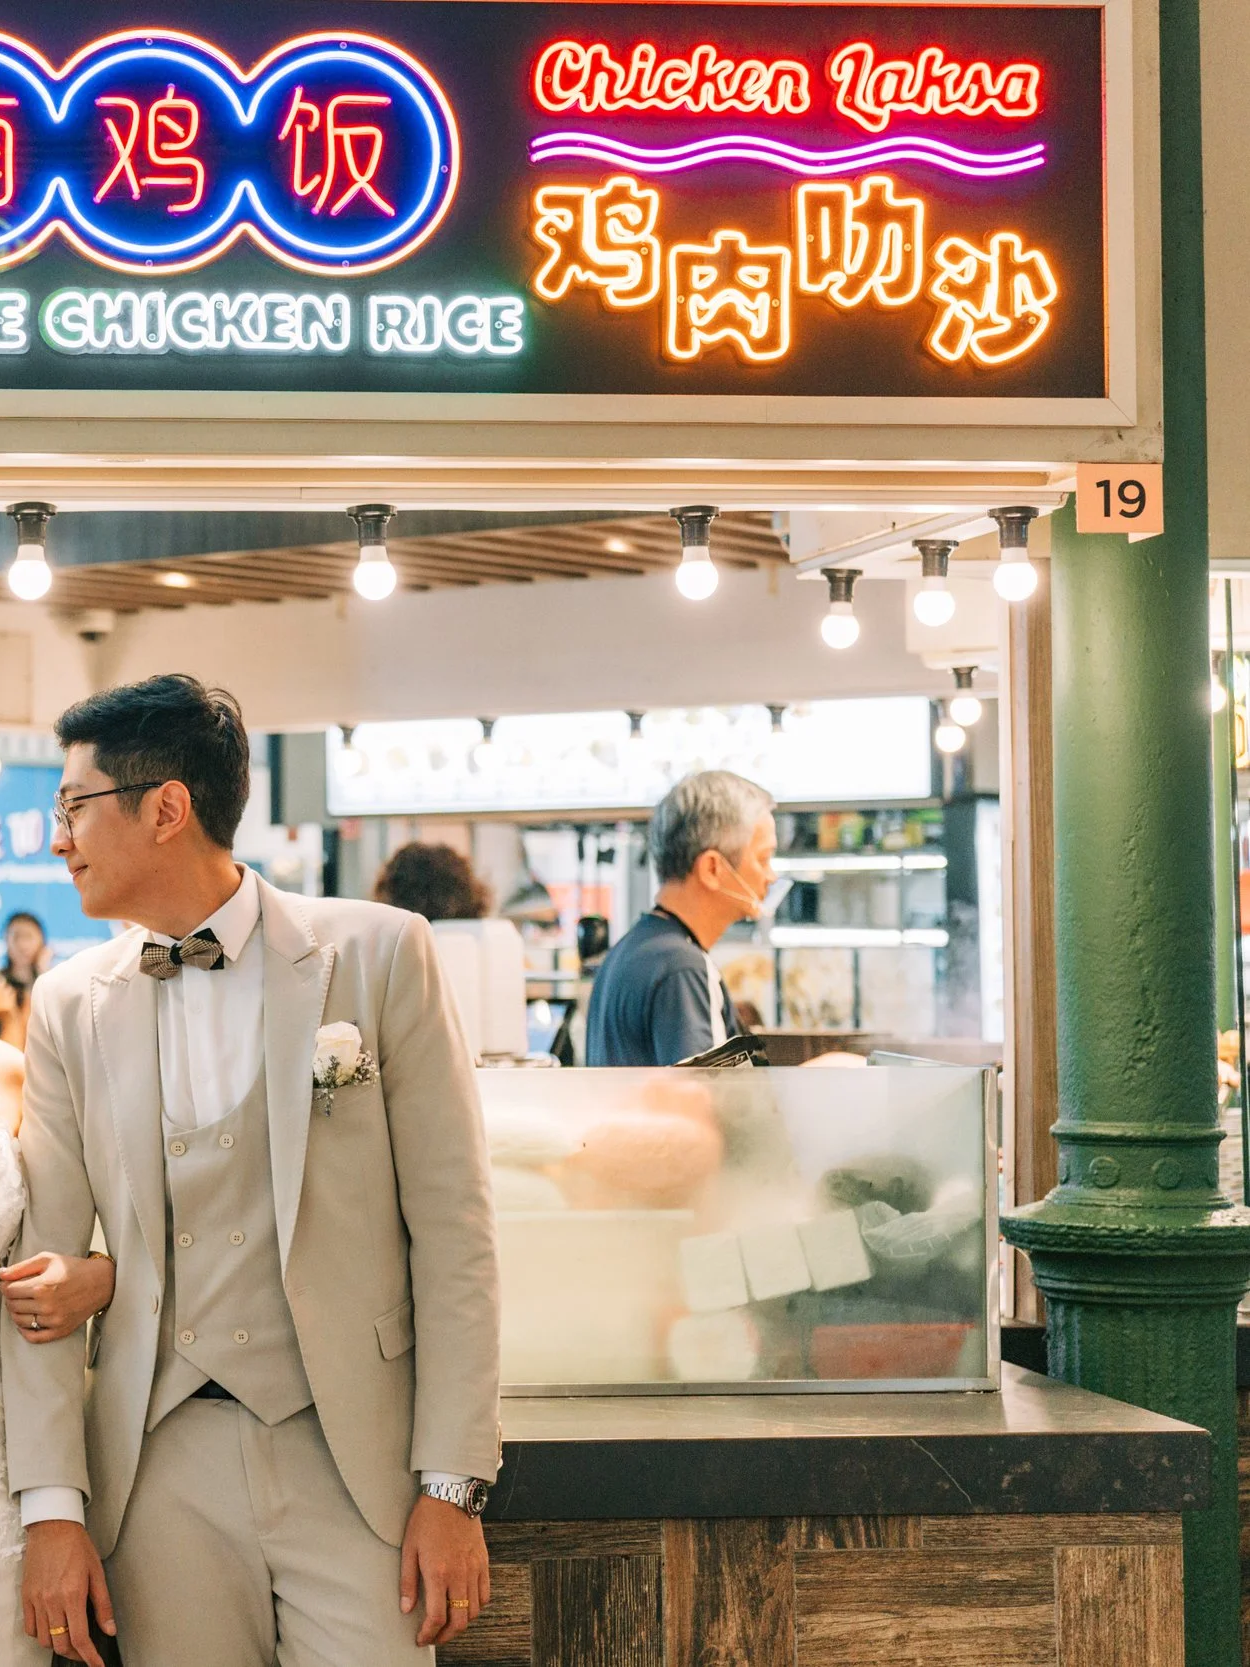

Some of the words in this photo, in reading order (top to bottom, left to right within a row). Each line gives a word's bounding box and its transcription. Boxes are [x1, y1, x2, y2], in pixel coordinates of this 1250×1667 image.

[534, 40, 810, 114] Chicken
[830, 42, 1040, 132] Laksa
[534, 176, 1057, 365] 鸡肉叻沙
[45, 291, 350, 352] CHICKEN
[368, 295, 524, 355] RICE
[1095, 479, 1146, 518] 19
